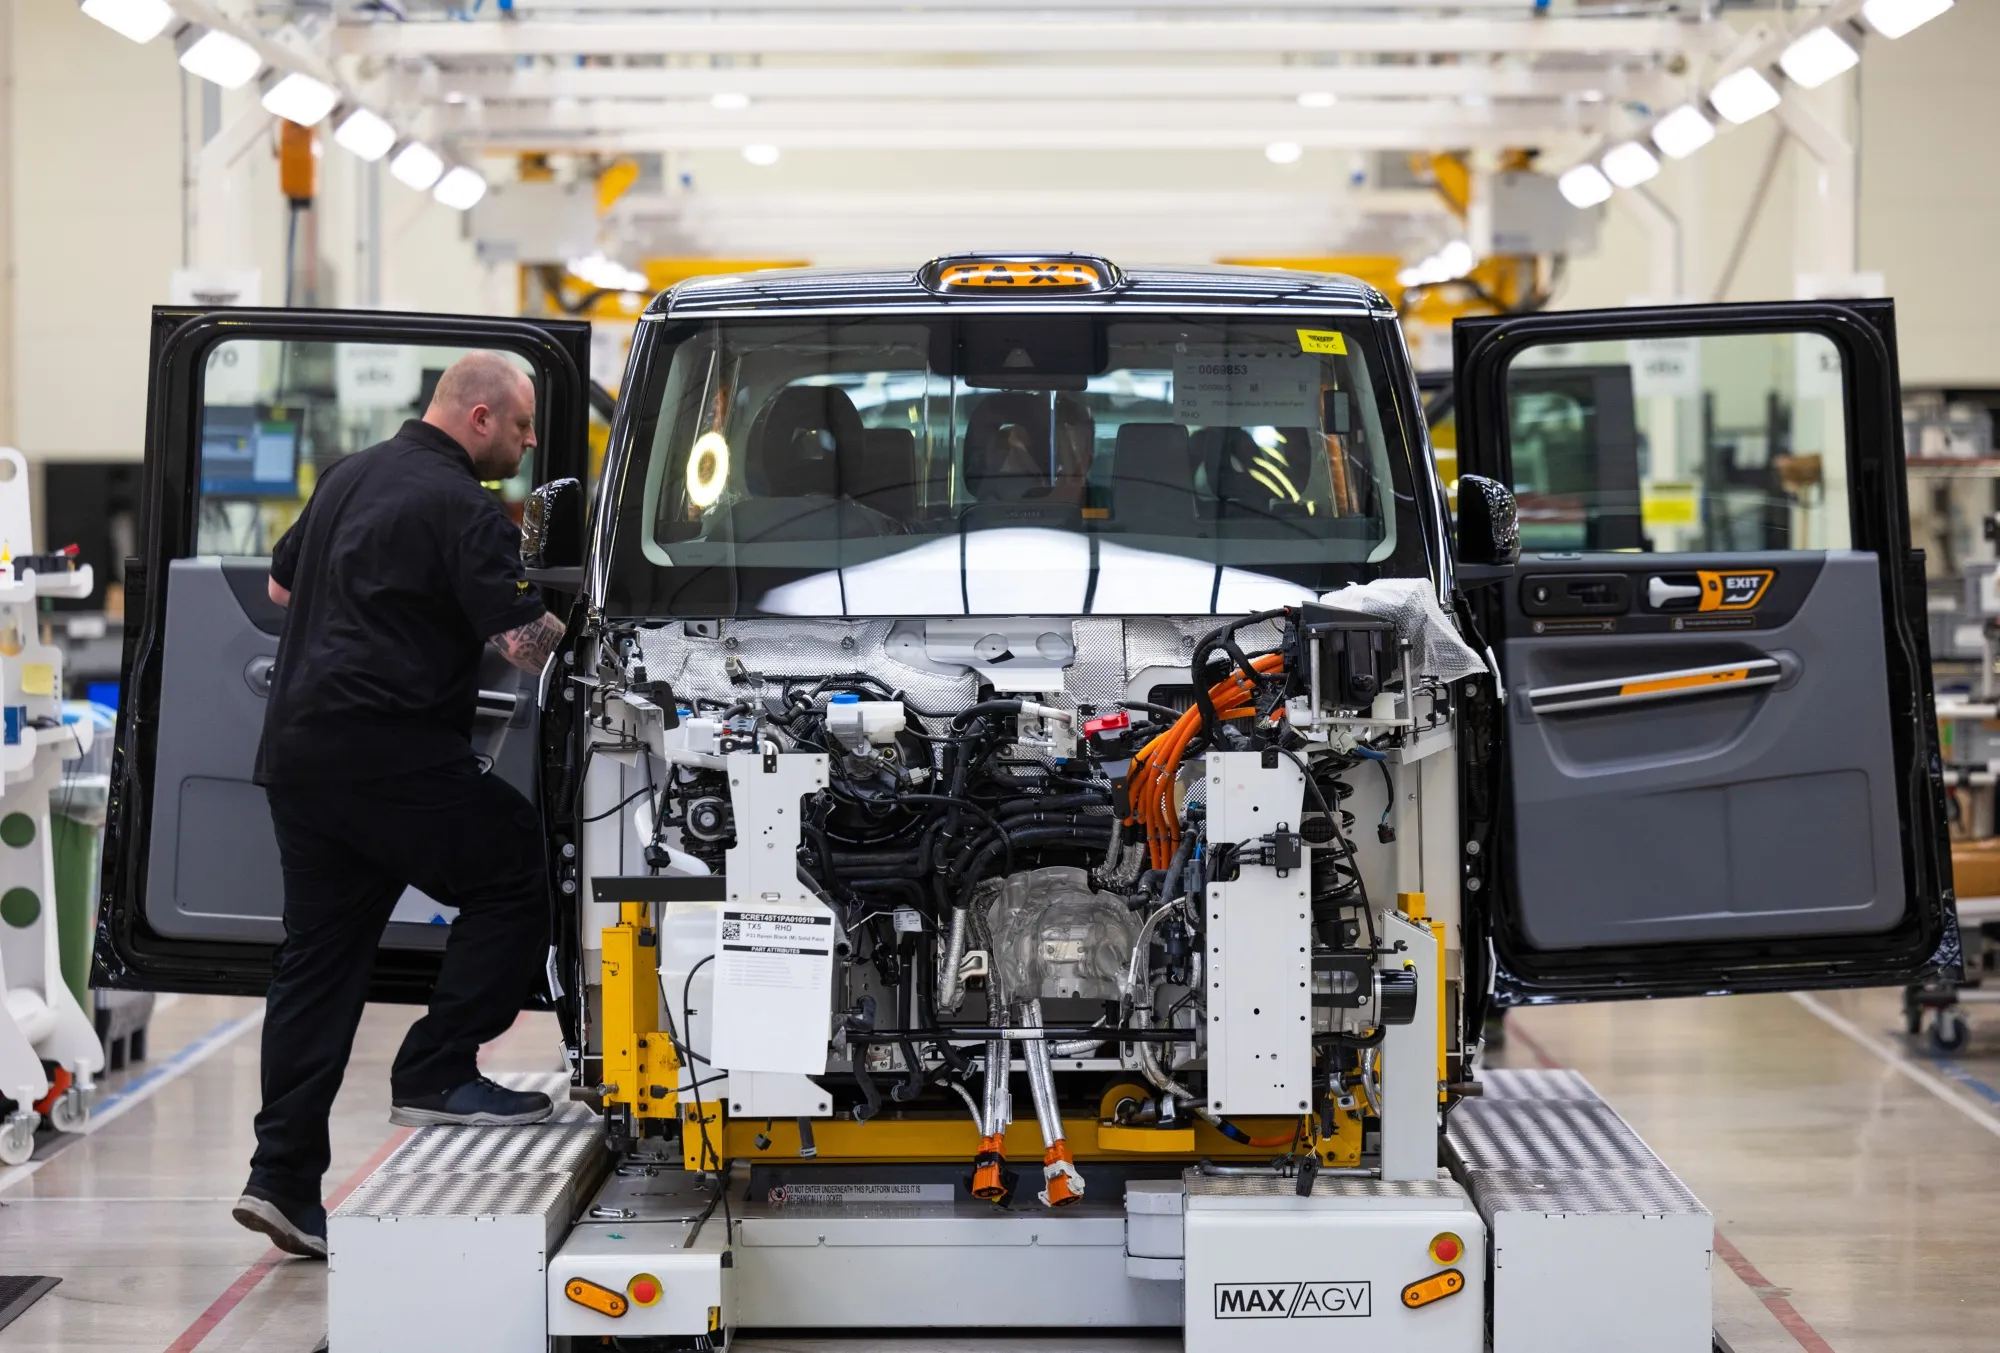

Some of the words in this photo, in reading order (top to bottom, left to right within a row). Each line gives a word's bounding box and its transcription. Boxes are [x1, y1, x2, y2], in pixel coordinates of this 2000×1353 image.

[954, 265, 1083, 284] TAXI
[1198, 364, 1248, 375] 0069853
[1725, 577, 1760, 590] EXIT
[775, 924, 792, 932] RHD
[787, 1185, 794, 1194] DO
[795, 1185, 804, 1194] NOT
[805, 1185, 821, 1194] ENTER
[822, 1185, 853, 1194] UNDERNEATH
[854, 1185, 864, 1194] THIS
[865, 1185, 890, 1194] PLATFORM
[891, 1185, 910, 1194] UNLESS
[911, 1185, 915, 1194] IT
[916, 1185, 921, 1194] IS
